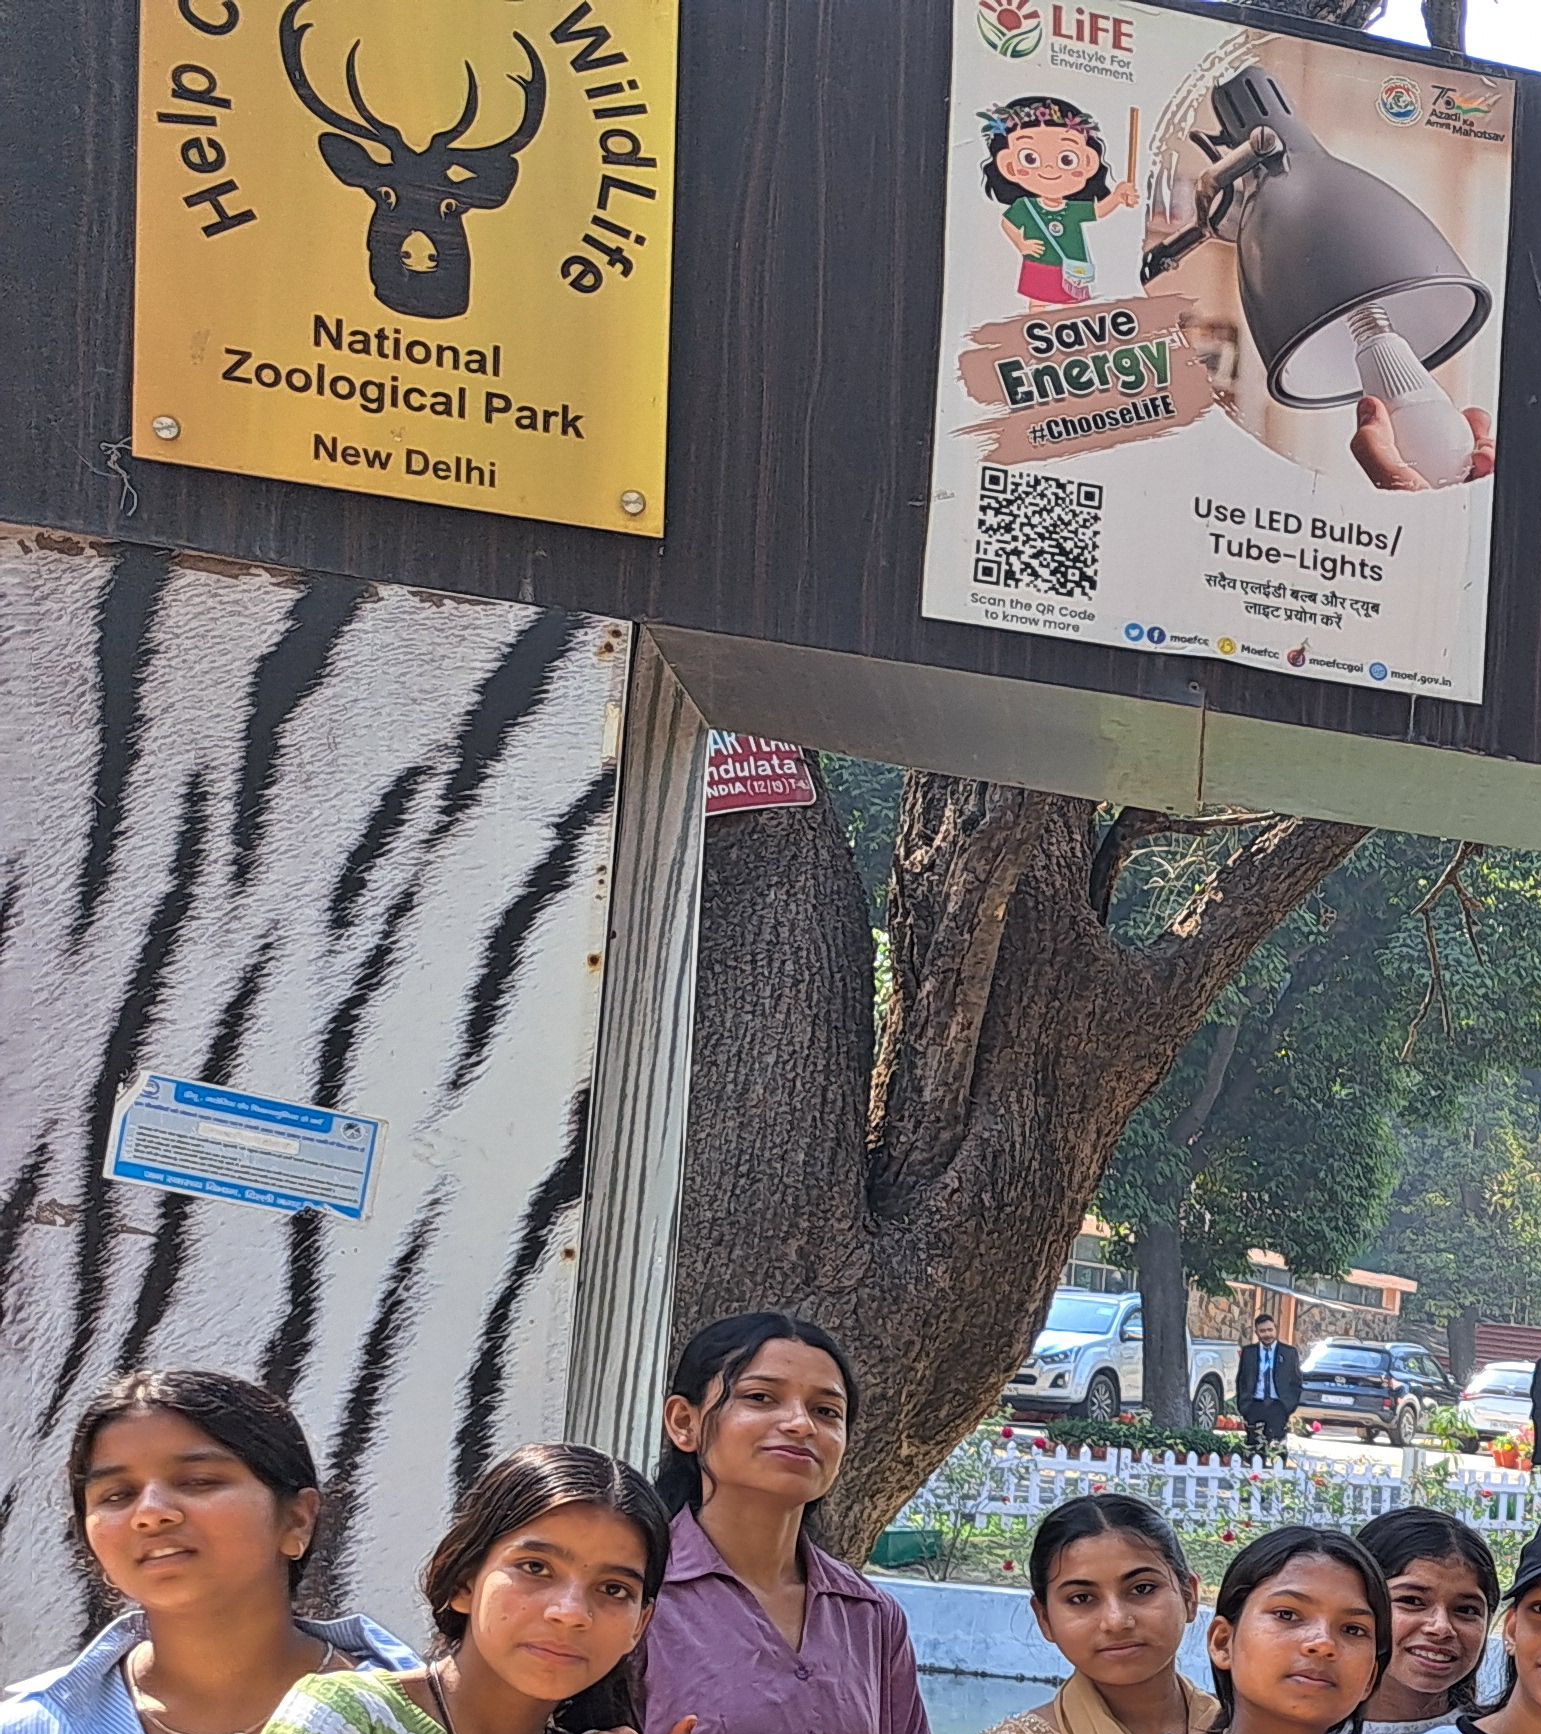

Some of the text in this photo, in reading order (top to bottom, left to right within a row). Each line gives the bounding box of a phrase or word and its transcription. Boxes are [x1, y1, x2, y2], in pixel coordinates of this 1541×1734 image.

[1052, 4, 1133, 53] LiFE
[1051, 43, 1131, 70] Lifestyle For
[1051, 55, 1134, 82] Environment
[1430, 108, 1460, 122] Azadi
[1452, 125, 1505, 142] Mahotsav
[156, 63, 258, 238] Help
[550, 0, 658, 294] WildLife
[313, 314, 500, 377] National
[1025, 310, 1136, 355] Save
[222, 347, 584, 439] Zoological Park
[997, 341, 1169, 405] Energy
[1030, 395, 1175, 444] #ChooseLiFE
[313, 433, 496, 488] New Delhi
[1194, 497, 1402, 556] Use LED Bulbs/
[1209, 533, 1383, 581] Tube-Lights
[971, 593, 1095, 621] Scan the QR Code
[1204, 572, 1236, 590] सदैव
[1240, 579, 1286, 600] एलईडी
[1290, 588, 1317, 604] बल्ब
[1322, 590, 1345, 610] और
[1243, 600, 1343, 630] लाइट प्रयोग करें
[985, 609, 1079, 633] to know more
